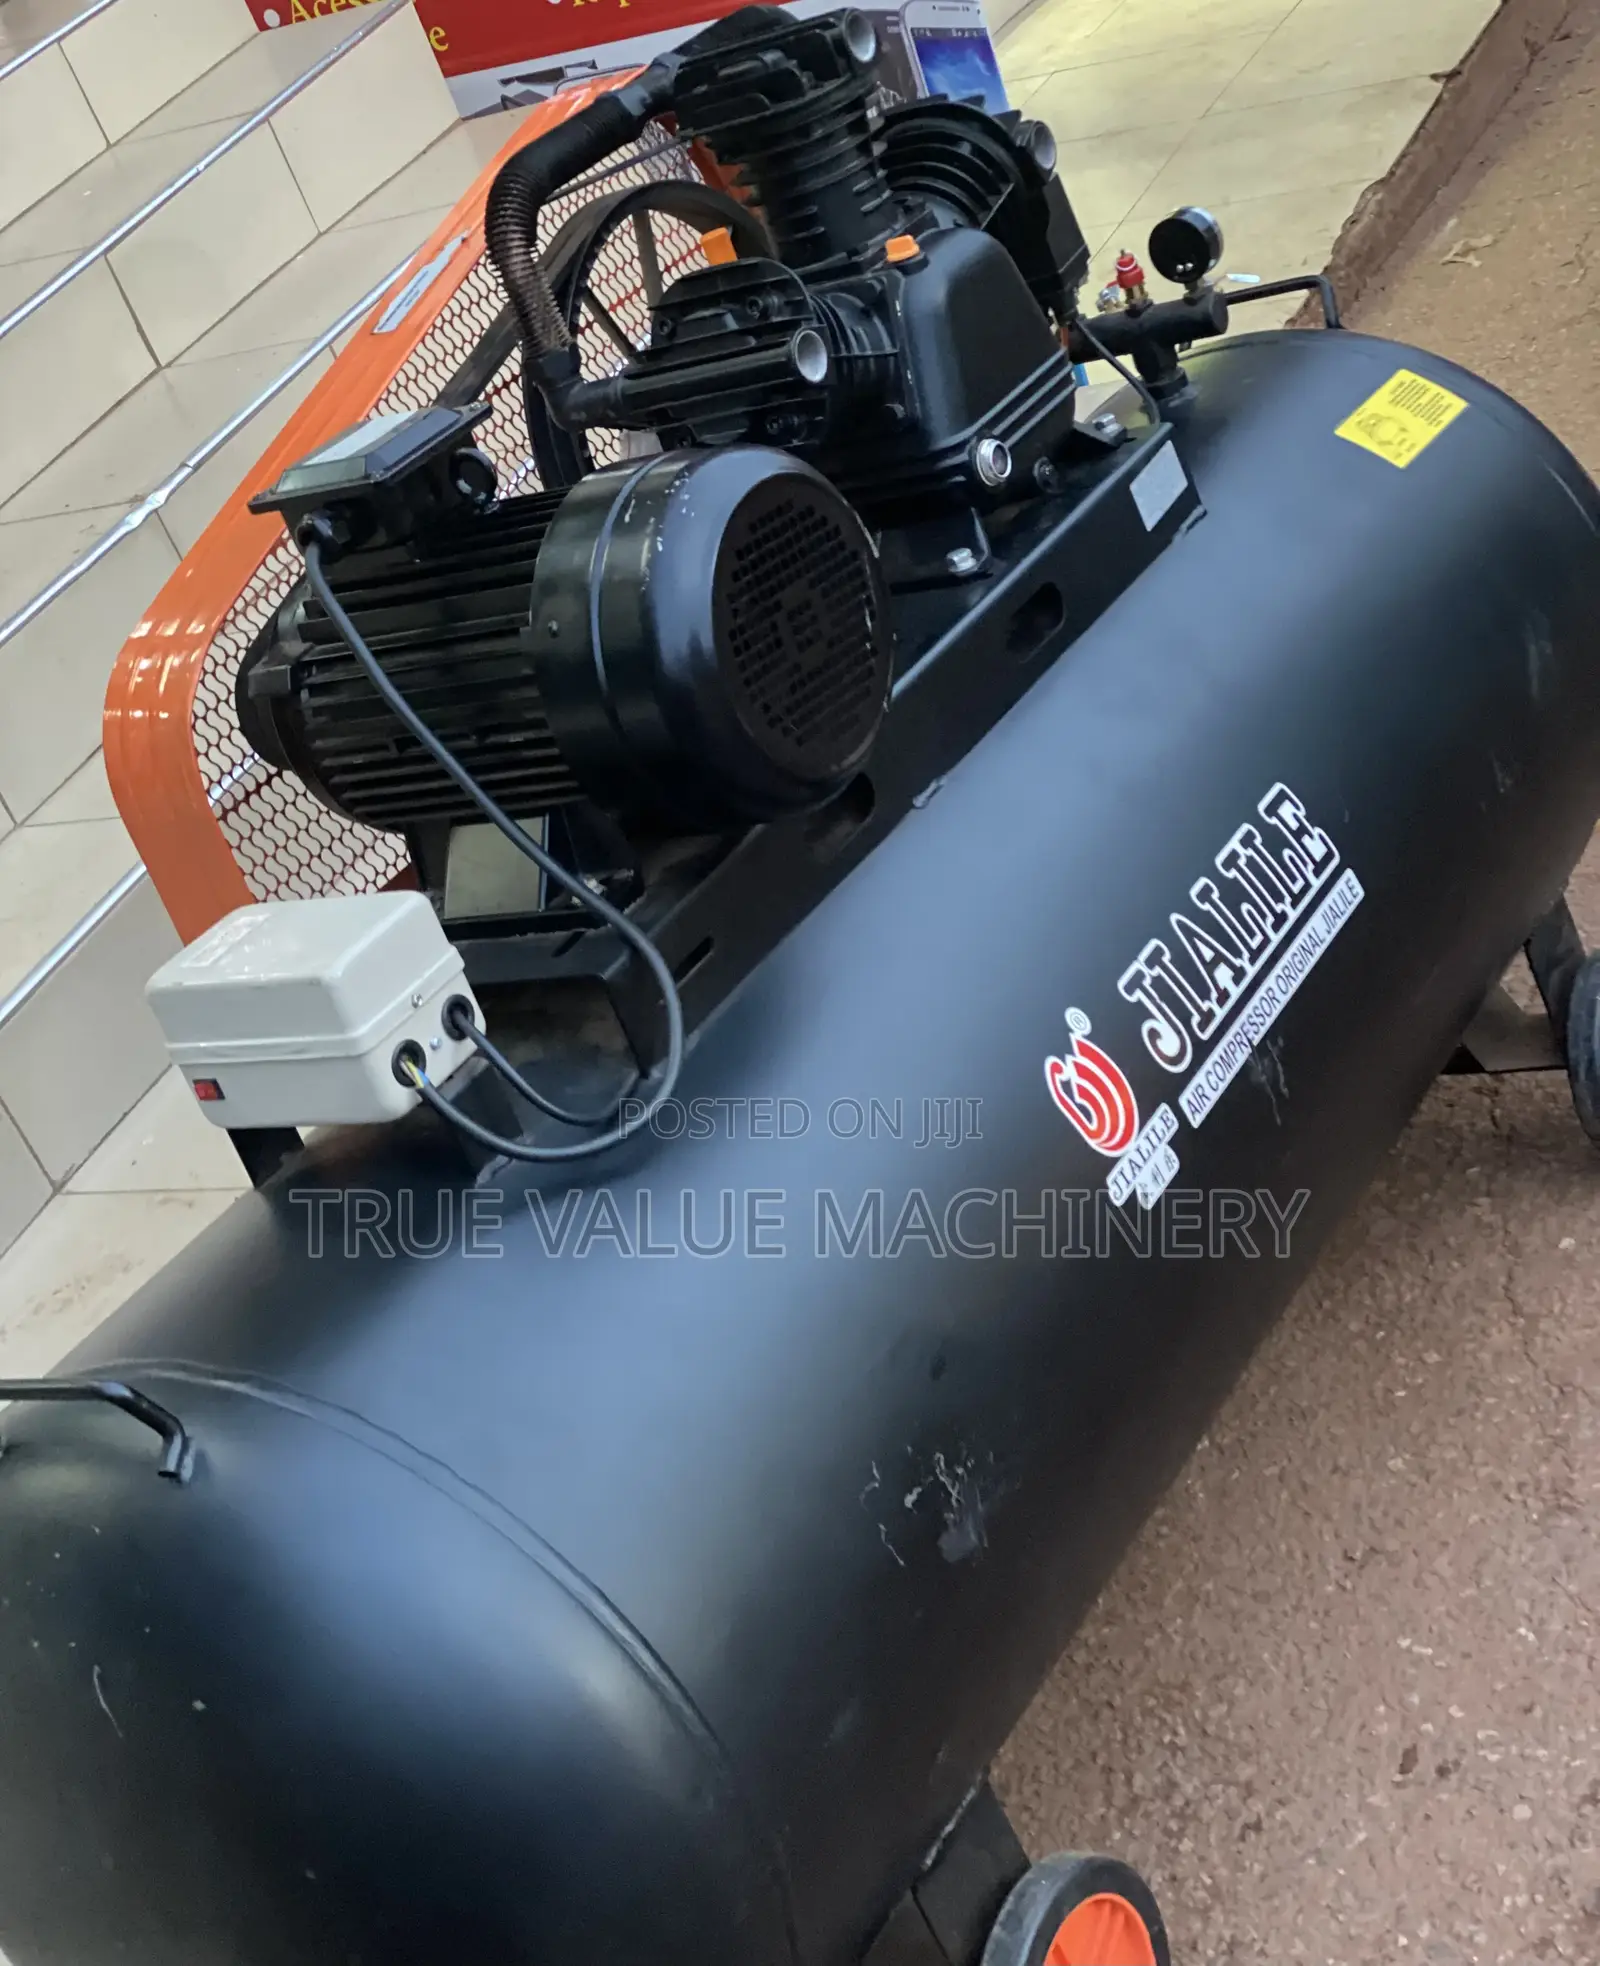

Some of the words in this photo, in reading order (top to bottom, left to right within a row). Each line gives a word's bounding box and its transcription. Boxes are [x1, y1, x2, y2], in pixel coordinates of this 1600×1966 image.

[1117, 782, 1340, 1072] JIALILE
[1186, 1084, 1211, 1121] AIR
[1205, 987, 1281, 1095] COMPRESSOR
[1276, 929, 1327, 996] ORIGINAL
[1321, 878, 1360, 935] JIALILE
[1111, 1109, 1175, 1201] JIALILE
